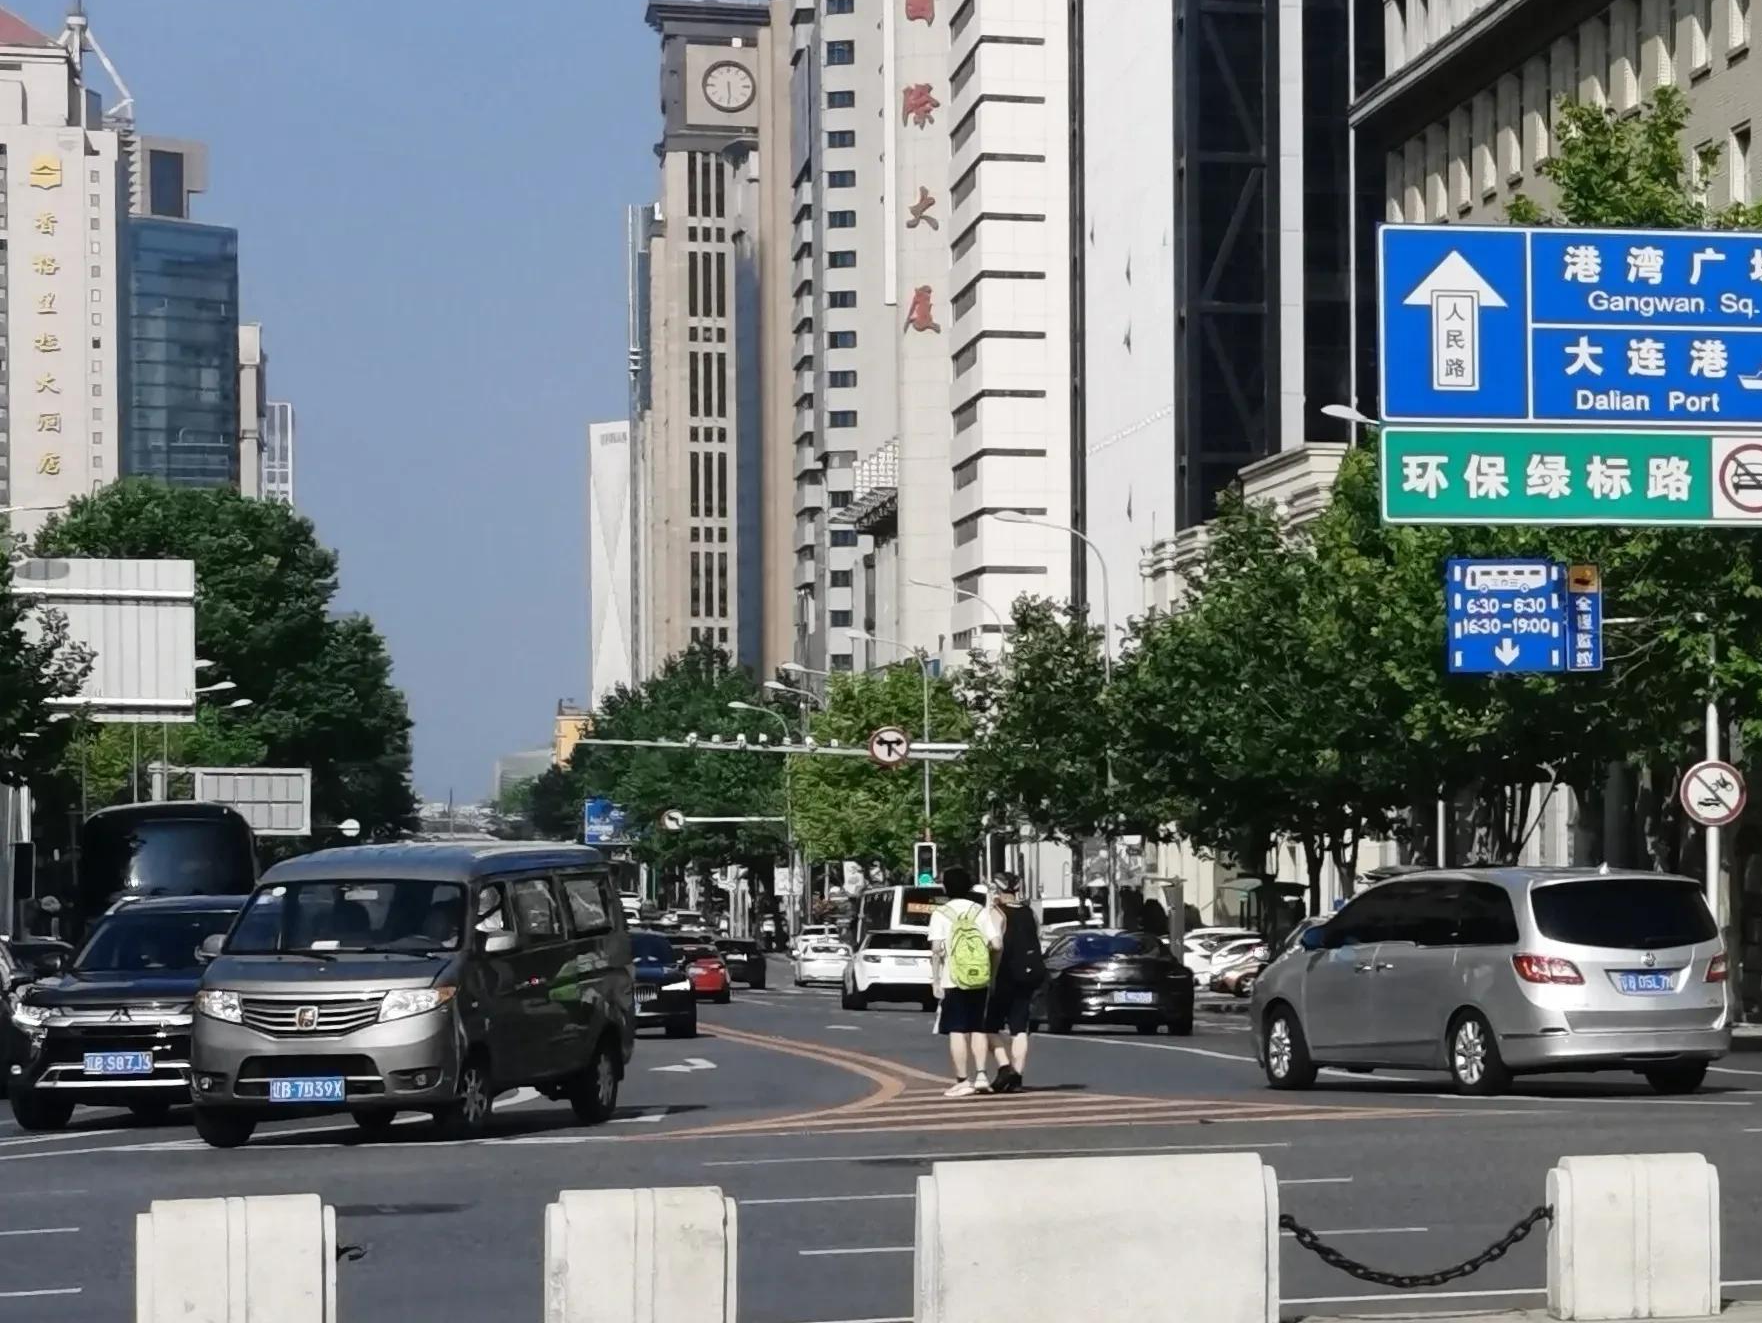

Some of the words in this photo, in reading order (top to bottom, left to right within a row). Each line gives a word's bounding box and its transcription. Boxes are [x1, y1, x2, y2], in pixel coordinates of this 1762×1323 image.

[1588, 291, 1705, 317] Gangwan
[1721, 293, 1760, 320] Sq.
[1444, 302, 1466, 379] 人民路
[1564, 335, 1728, 378] 大连港
[1576, 389, 1650, 411] Dalian
[1669, 391, 1720, 413] Port
[1402, 454, 1693, 502] 环保绿标路
